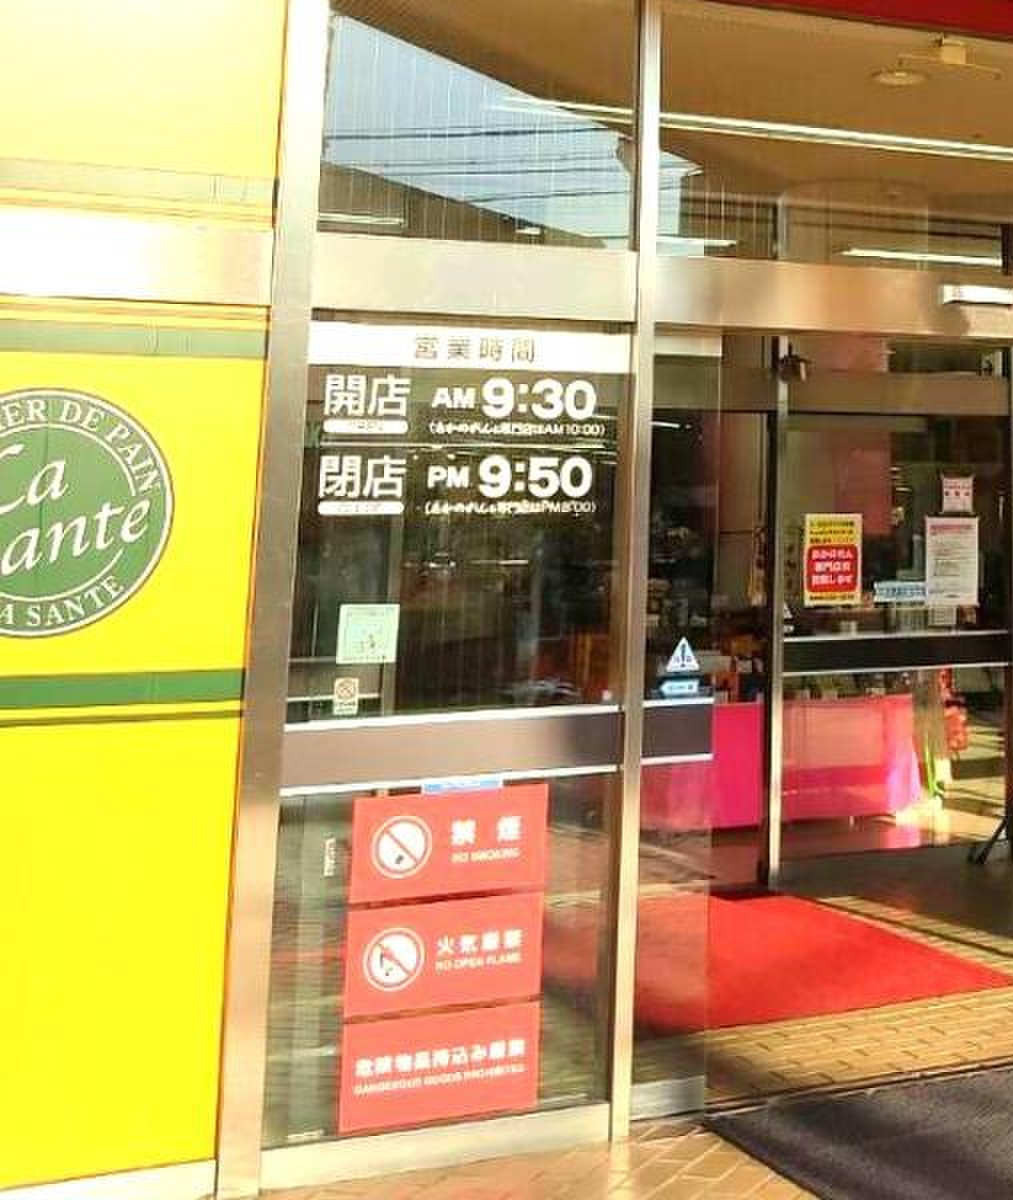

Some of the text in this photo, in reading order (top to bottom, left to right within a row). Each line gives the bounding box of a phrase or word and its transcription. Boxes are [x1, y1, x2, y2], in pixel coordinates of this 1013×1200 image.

[415, 335, 535, 363] 営業時間
[324, 374, 597, 420] 開店 AM 9:30
[60, 401, 106, 432] DE
[103, 429, 164, 497] PAIN
[318, 454, 593, 499] 閉店 PM 9:50
[27, 575, 125, 627] SANTE
